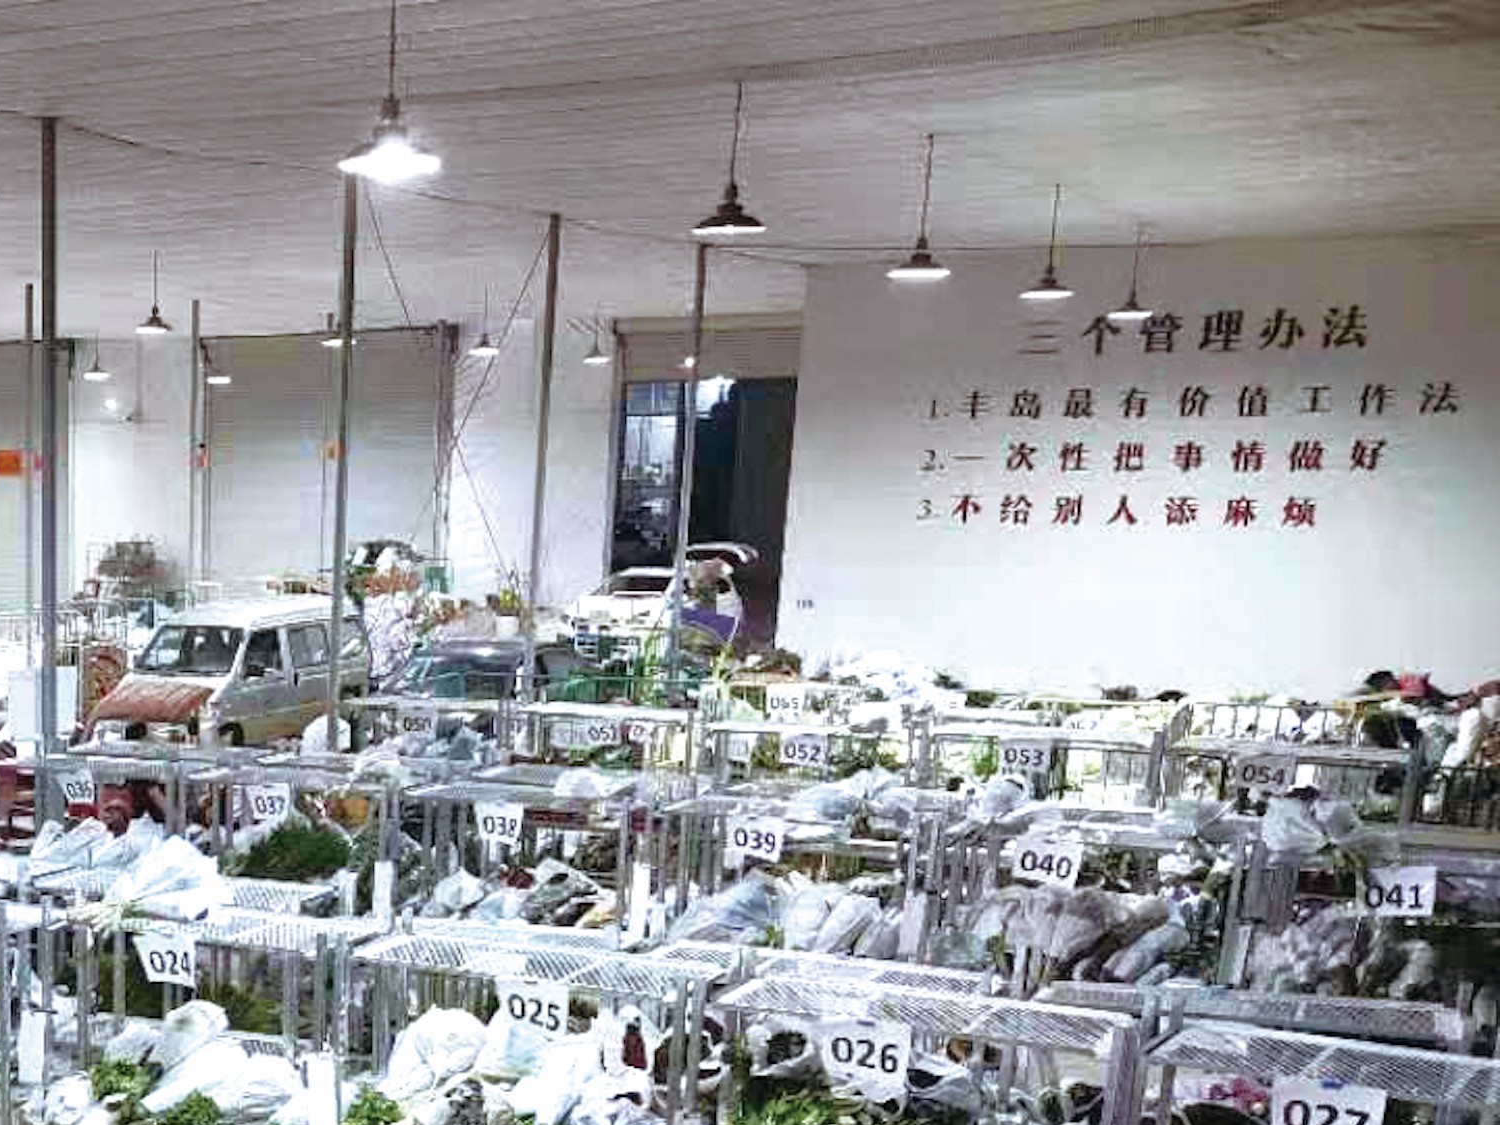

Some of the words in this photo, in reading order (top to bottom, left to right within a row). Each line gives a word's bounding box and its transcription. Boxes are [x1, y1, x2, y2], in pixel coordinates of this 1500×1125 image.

[1015, 305, 1367, 354] 三个管理办法
[918, 440, 1387, 473] 2.一次性把事情做好
[916, 494, 1317, 526] 3.不给别人添麻烦
[784, 742, 821, 763] 052
[1004, 748, 1044, 767] 053
[1242, 764, 1285, 785] 054
[255, 796, 286, 815] 037
[483, 816, 517, 836] 038
[735, 827, 776, 852] 039
[1020, 850, 1072, 878] 040
[1366, 884, 1423, 908] 041
[149, 950, 192, 976] 024
[508, 994, 560, 1031] 025
[831, 1037, 898, 1073] 026
